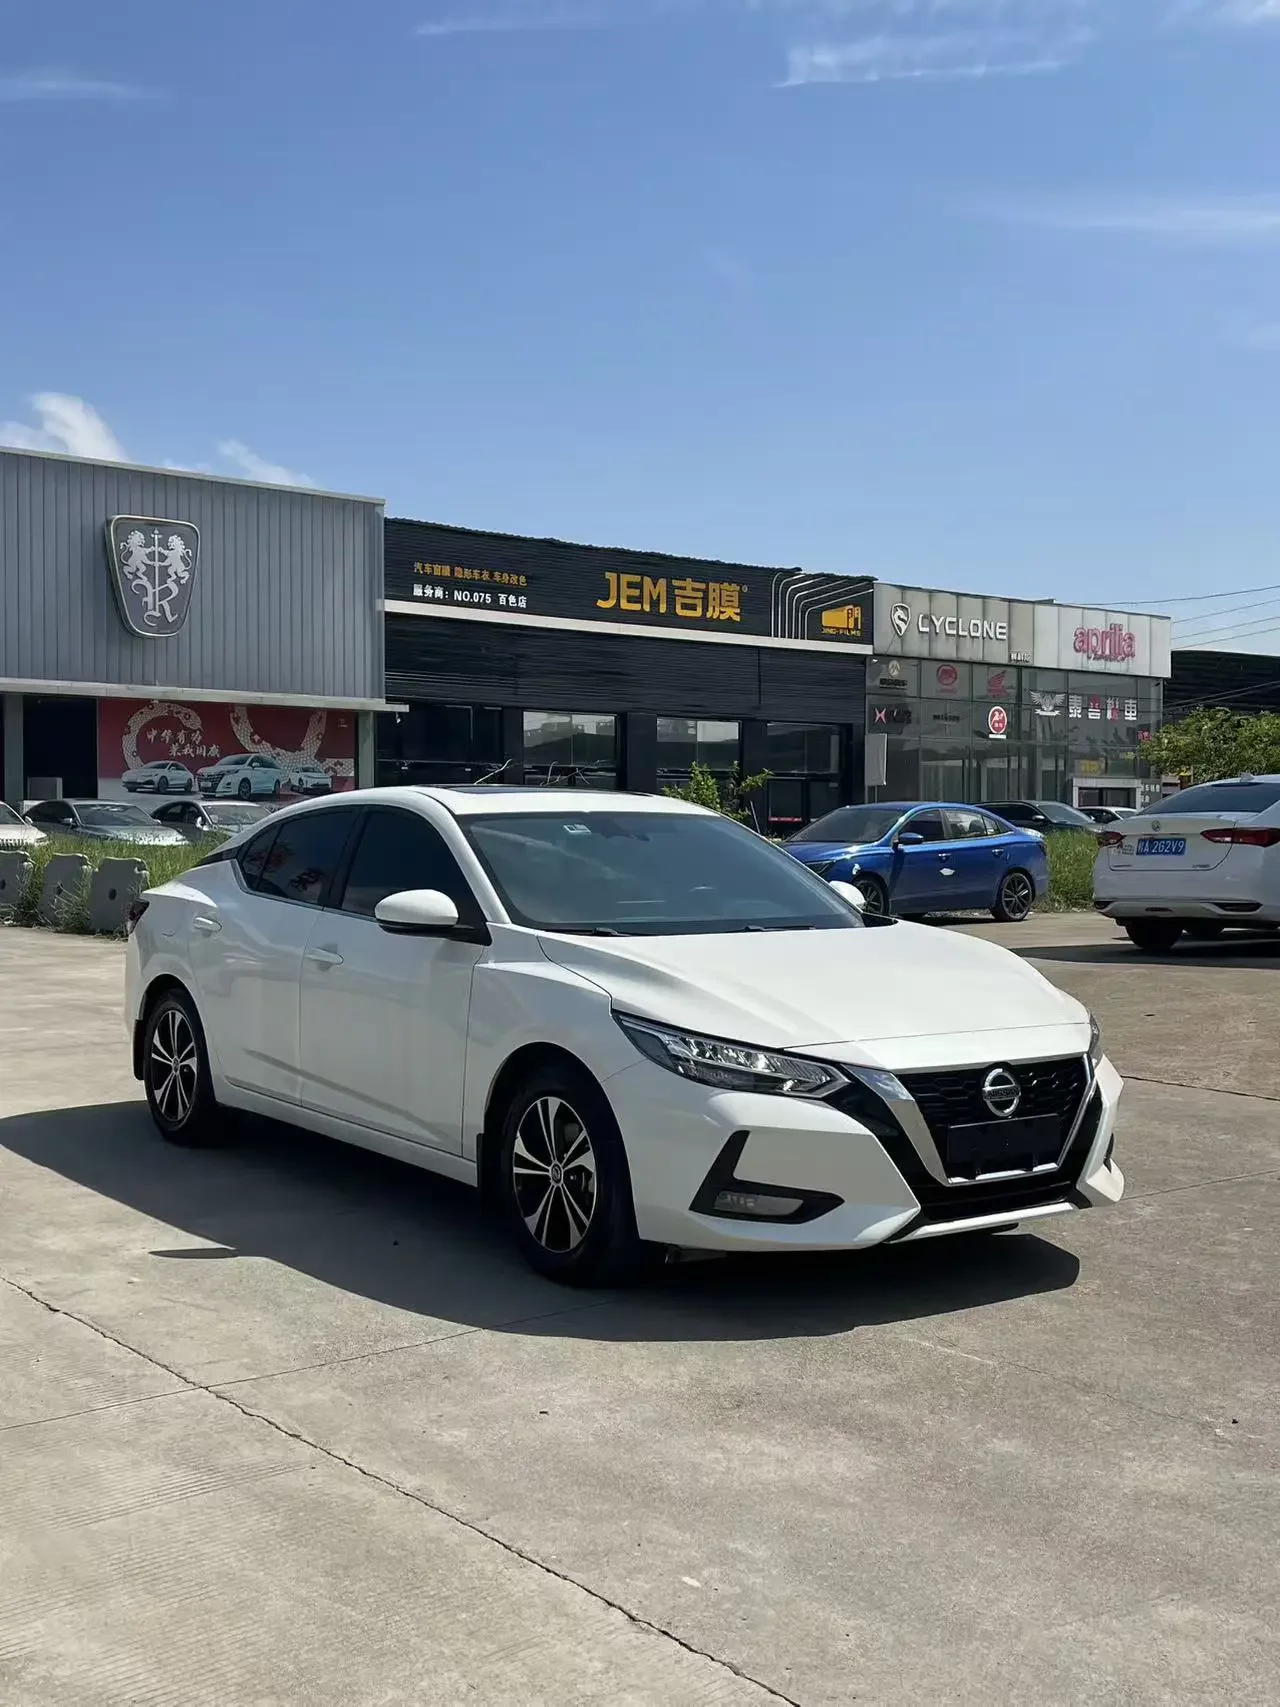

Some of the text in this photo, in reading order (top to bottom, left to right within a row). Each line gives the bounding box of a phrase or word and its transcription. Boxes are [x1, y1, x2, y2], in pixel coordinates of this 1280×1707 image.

[454, 566, 490, 581] 隐形车衣
[493, 571, 527, 586] 车身改色
[453, 590, 492, 604] NO.075
[498, 593, 527, 608] 百色店
[596, 571, 741, 622] JEM 吉膜
[918, 613, 1008, 640] CYCLONE
[1073, 622, 1136, 659] aprilia
